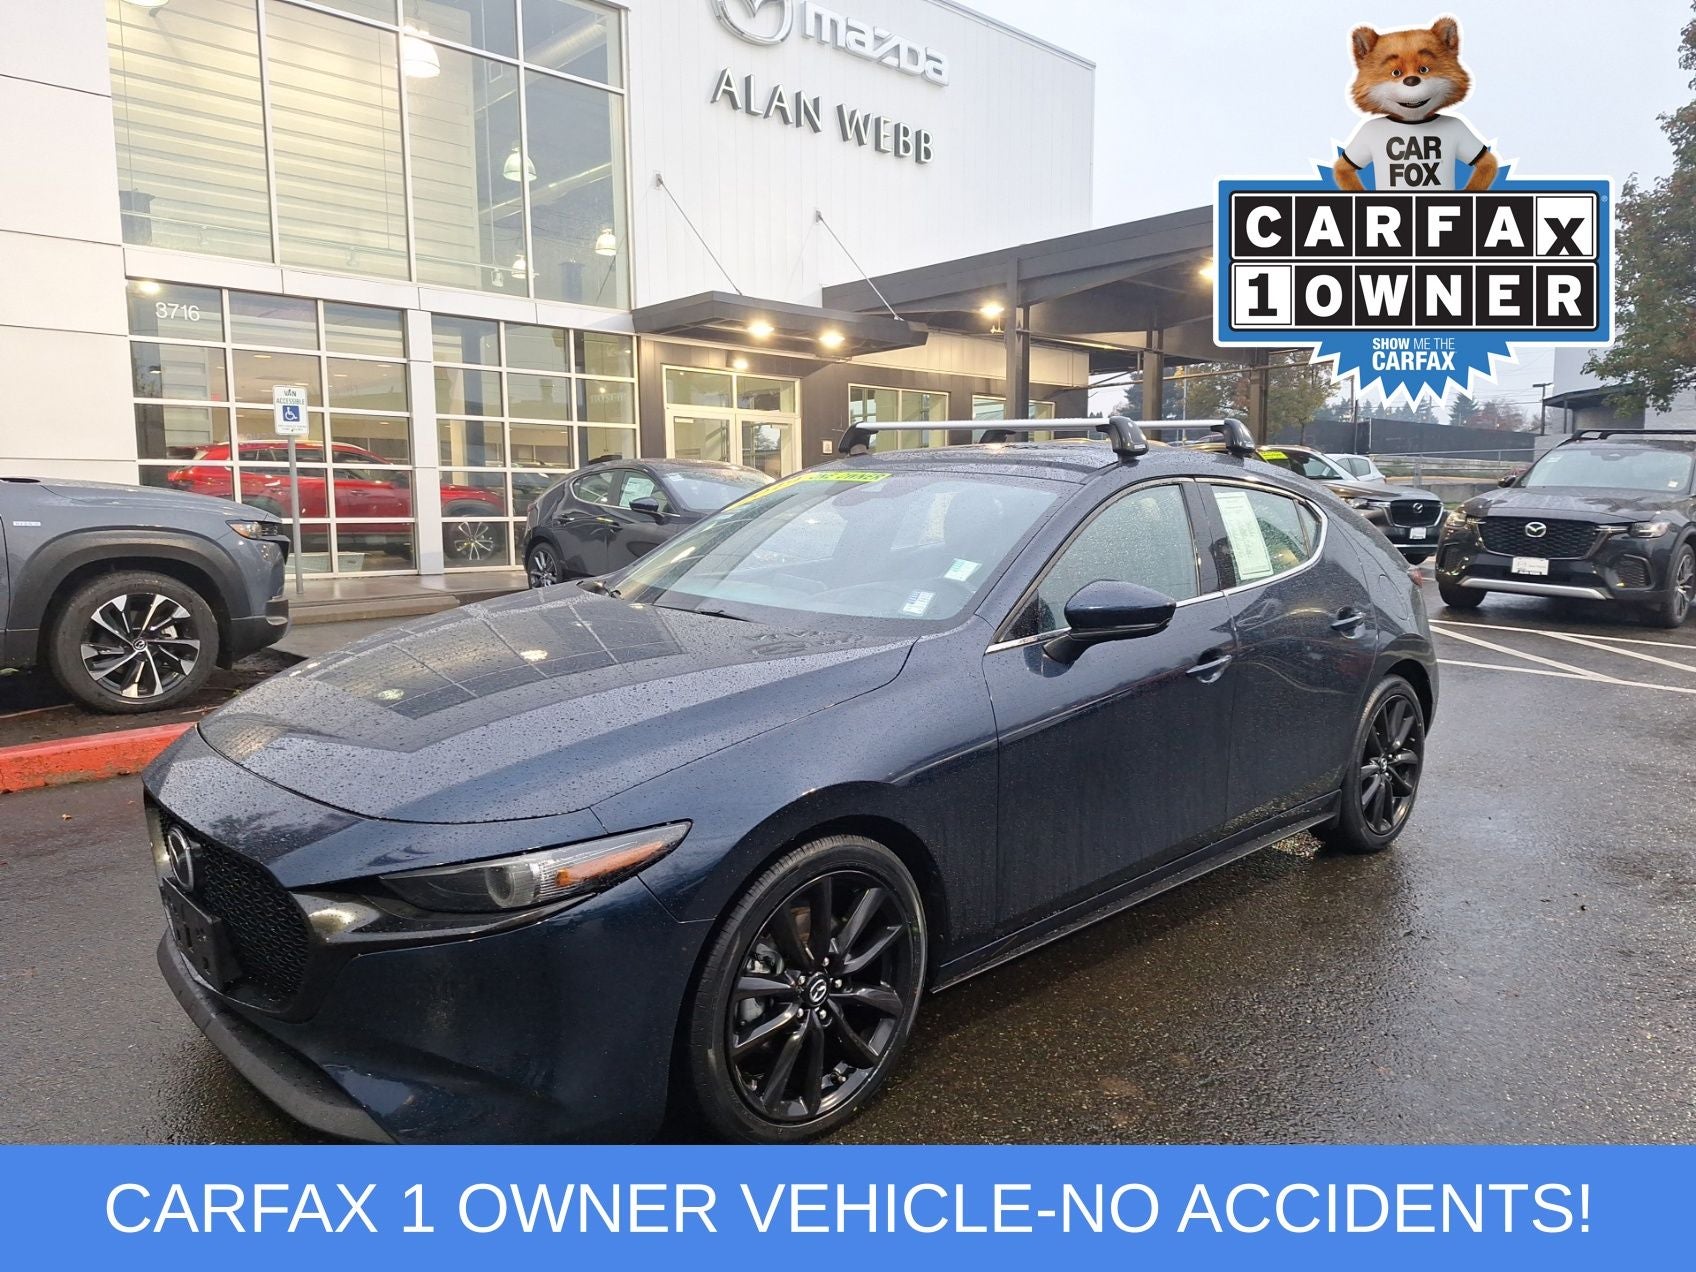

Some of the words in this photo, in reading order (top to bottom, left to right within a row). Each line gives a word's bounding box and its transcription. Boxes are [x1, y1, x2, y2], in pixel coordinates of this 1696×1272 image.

[710, 66, 822, 134] ALAN
[836, 103, 934, 164] WEBB
[155, 301, 200, 321] 3716
